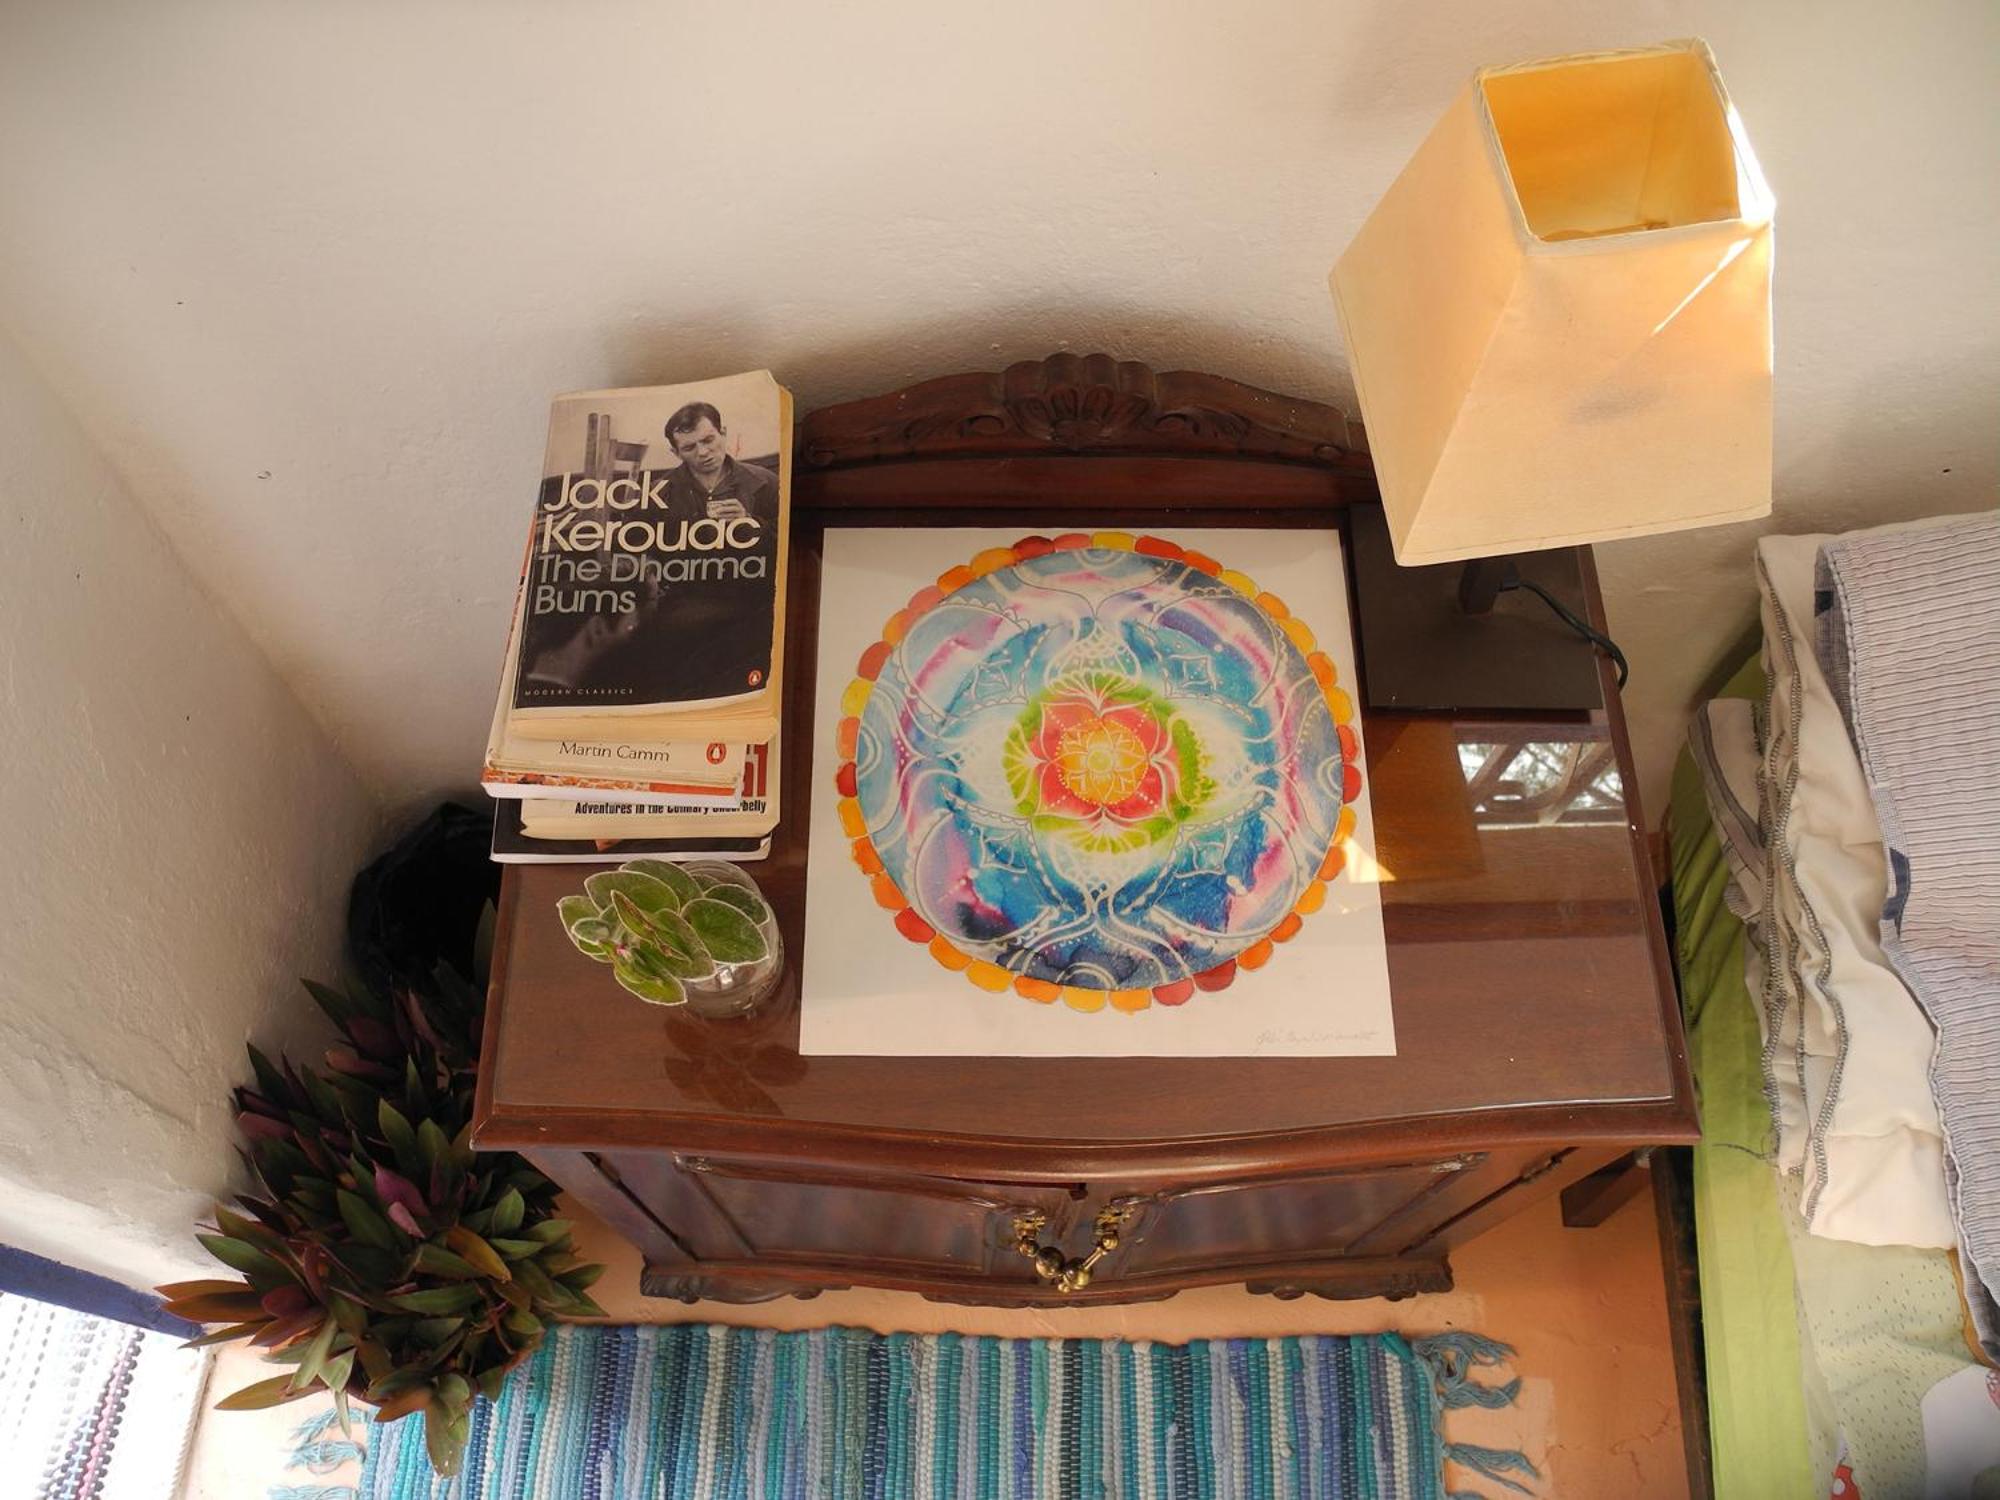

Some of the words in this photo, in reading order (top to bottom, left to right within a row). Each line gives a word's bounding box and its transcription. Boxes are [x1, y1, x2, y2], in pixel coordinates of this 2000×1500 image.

[543, 470, 670, 511] Jack
[541, 511, 761, 554] Kerouac
[538, 553, 602, 584] The
[609, 552, 767, 583] Dharma
[534, 584, 637, 615] Bums
[559, 740, 612, 758] Martin
[616, 744, 671, 762] Camm
[575, 802, 633, 815] Adventures
[635, 804, 645, 814] in
[648, 804, 664, 814] the
